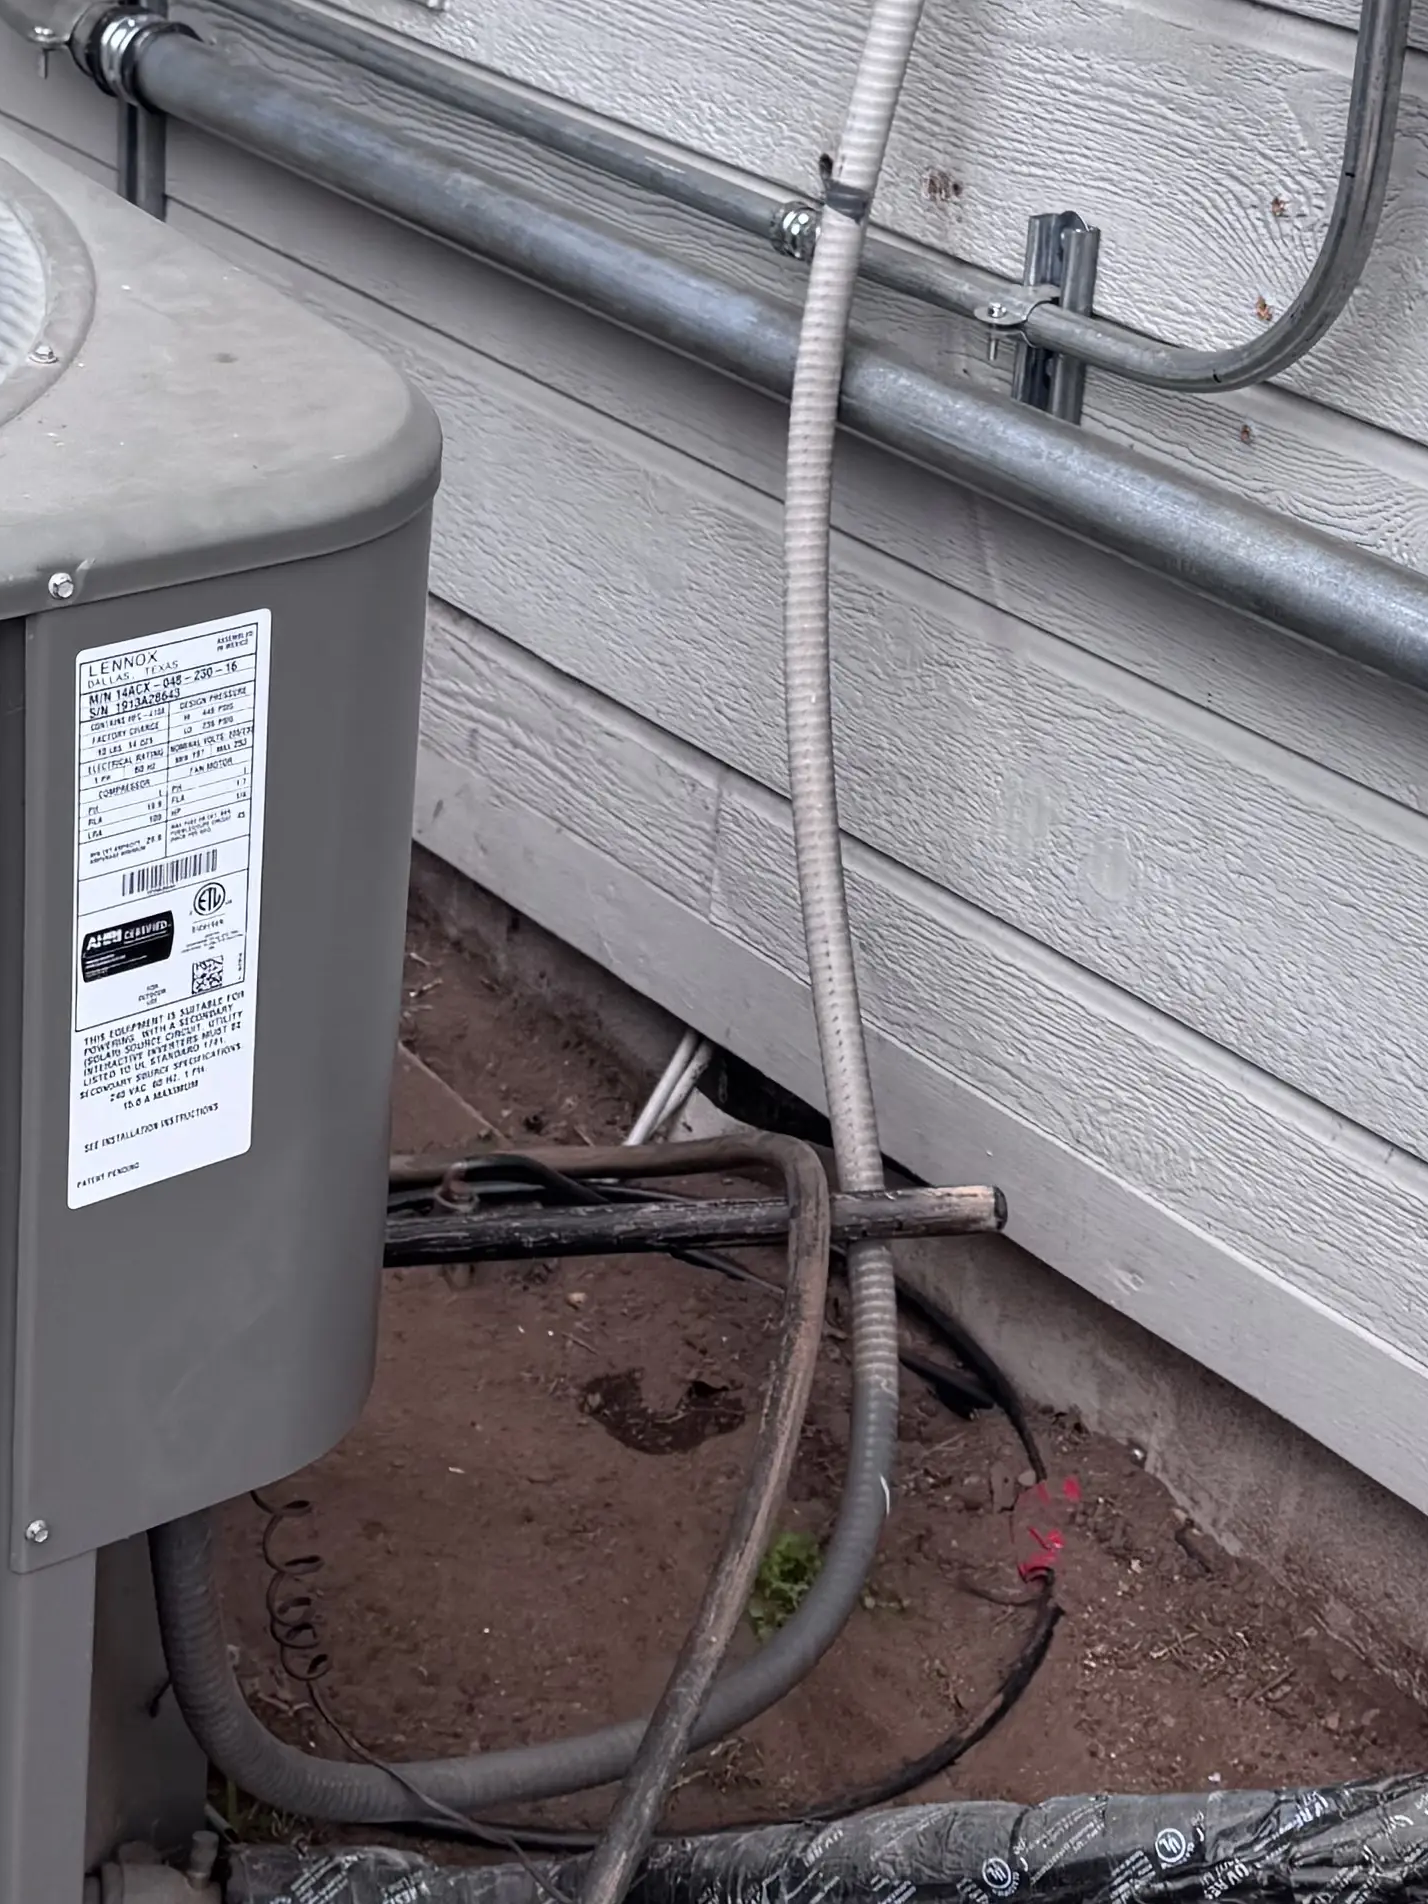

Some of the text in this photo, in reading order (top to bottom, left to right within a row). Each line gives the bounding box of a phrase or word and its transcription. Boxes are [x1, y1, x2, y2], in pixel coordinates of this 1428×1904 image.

[89, 649, 158, 677] LENNOX
[145, 660, 179, 675] TEXAS
[89, 691, 111, 706] M/N
[89, 688, 181, 719] S/N 1913A28643
[98, 779, 150, 800] COMPRESSOR
[84, 1035, 105, 1046] THIS
[109, 1014, 164, 1039] EQUIPMENT
[180, 998, 223, 1018] SUITABLE
[83, 1069, 116, 1087] LISTED
[120, 1066, 131, 1076] TO
[150, 1043, 200, 1066] STANDARD
[84, 1051, 143, 1077] INTERACTIVE
[147, 1034, 198, 1057] INVERTERS
[202, 1026, 228, 1040] MUST
[136, 1065, 170, 1082] SOURCE
[102, 1123, 158, 1147] INSTALLATION
[160, 1103, 219, 1128] INSTRUCTIONS
